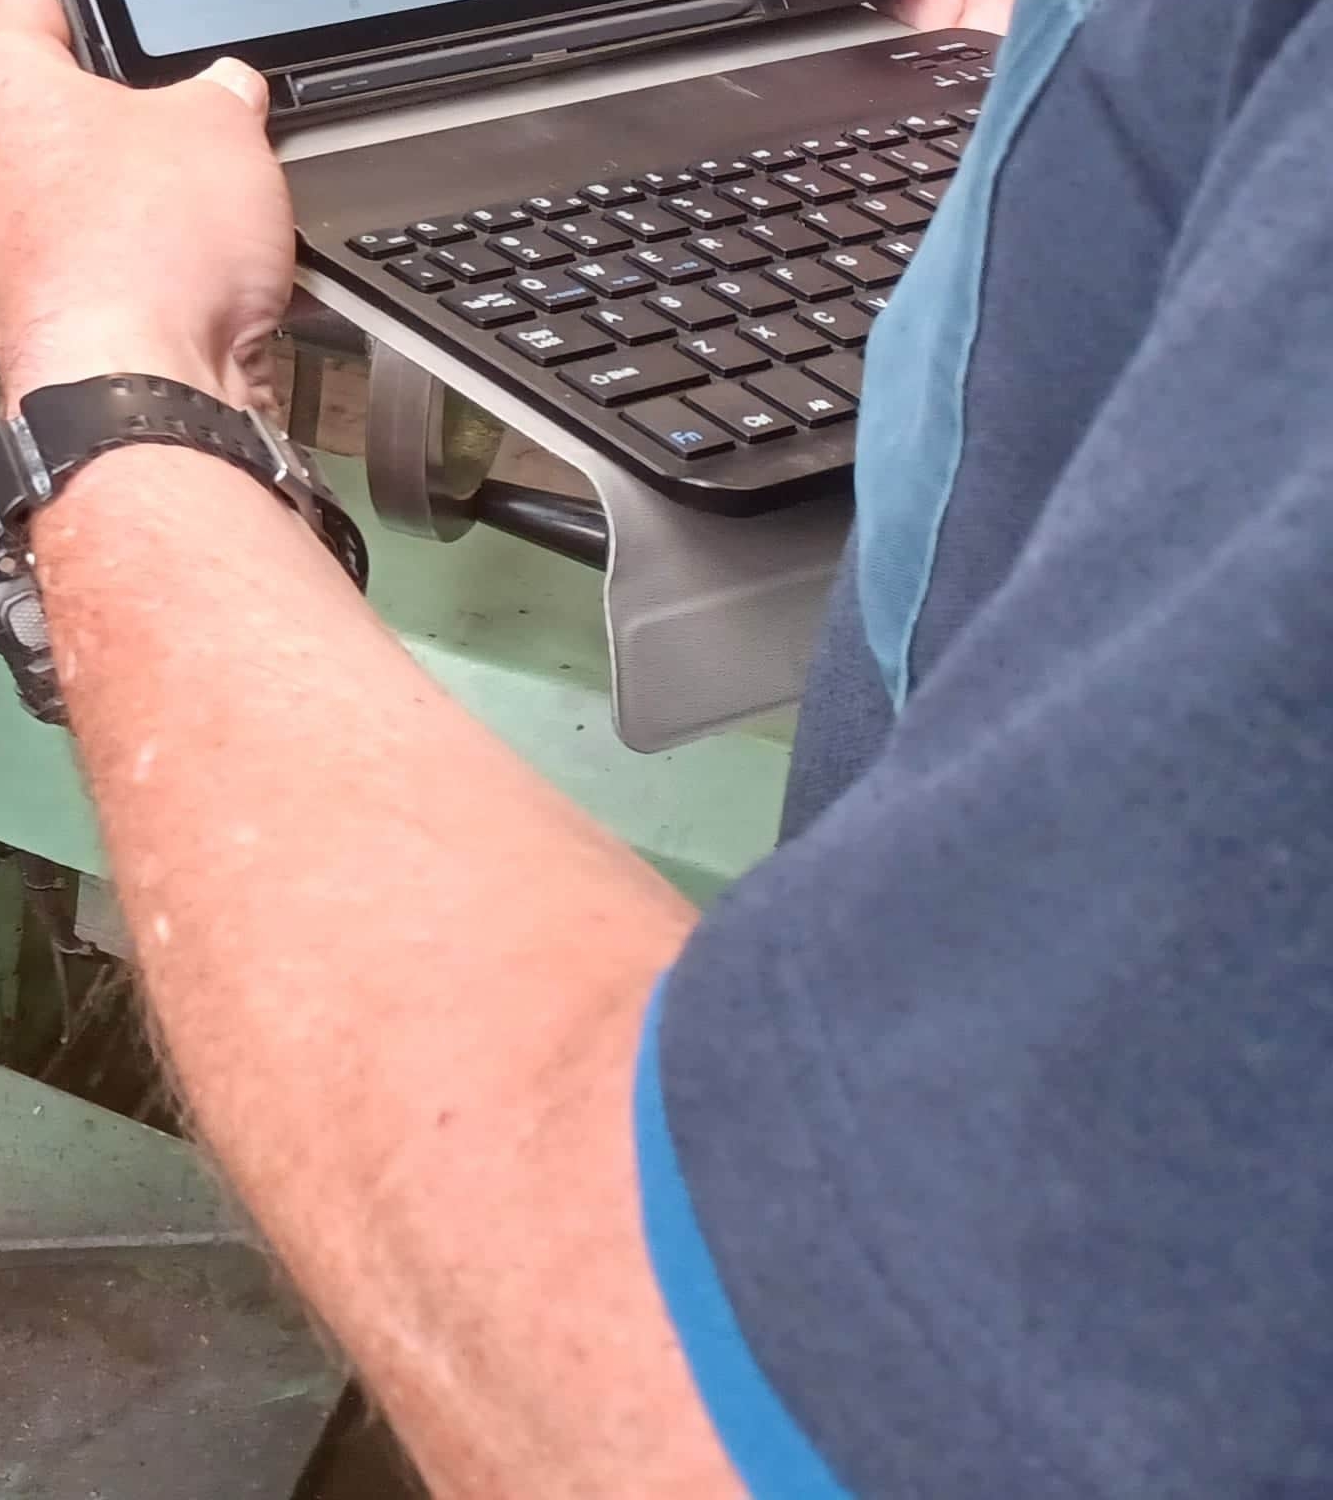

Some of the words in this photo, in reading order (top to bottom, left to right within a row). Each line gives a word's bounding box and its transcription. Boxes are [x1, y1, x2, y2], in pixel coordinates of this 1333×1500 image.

[638, 251, 663, 263] E
[698, 237, 724, 250] R
[599, 311, 624, 324] A
[752, 325, 777, 339] X
